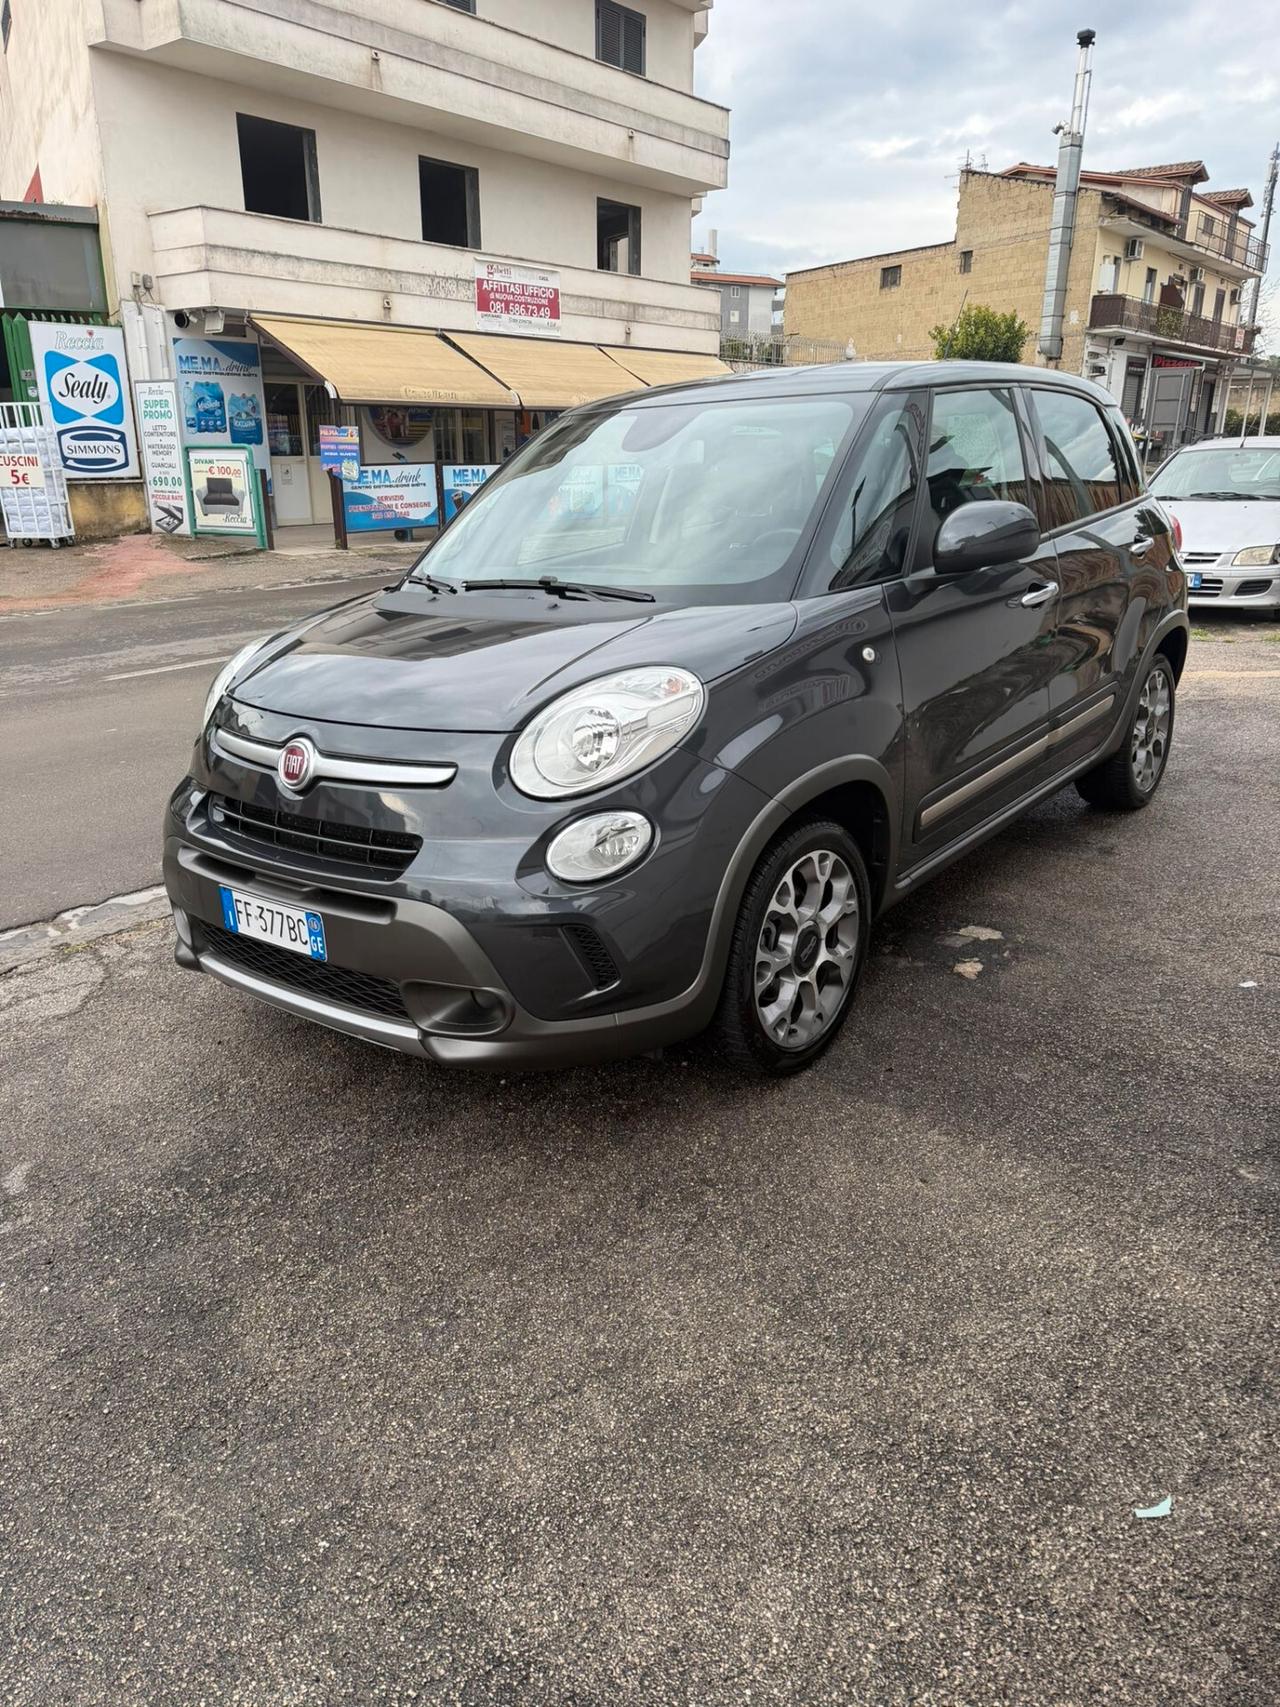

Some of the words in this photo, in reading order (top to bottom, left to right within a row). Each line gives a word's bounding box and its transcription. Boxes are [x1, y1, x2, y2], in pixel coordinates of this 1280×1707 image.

[482, 280, 523, 295] AFFITTASI
[524, 285, 554, 299] UFFICIO
[515, 295, 549, 306] COSTRUZIONE
[58, 372, 109, 404] Sealy
[143, 399, 170, 410] SUPER
[143, 410, 173, 420] PROMO
[66, 444, 121, 455] SIMMONS
[400, 501, 432, 509] CONSEGNE
[284, 754, 303, 774] FIAT
[310, 935, 324, 954] GE
